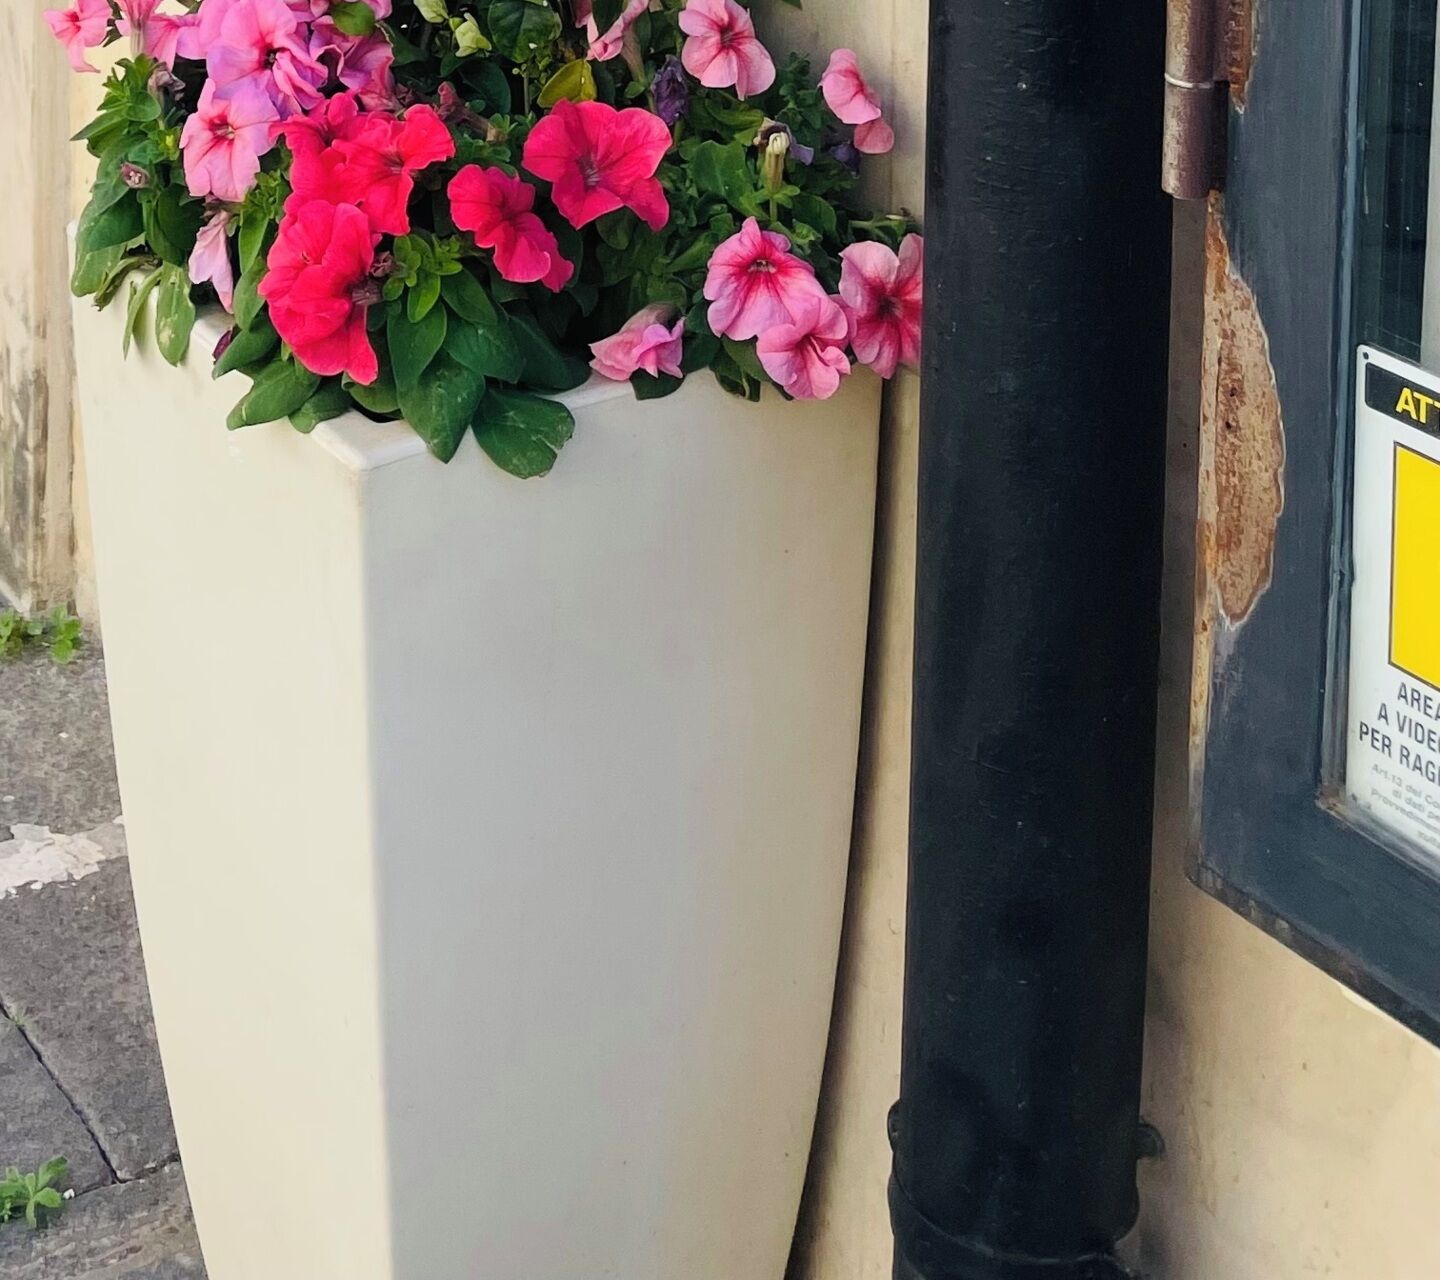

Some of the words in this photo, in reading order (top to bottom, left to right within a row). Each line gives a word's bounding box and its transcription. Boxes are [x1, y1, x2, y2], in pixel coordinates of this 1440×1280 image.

[1360, 721, 1392, 758] PER
[1377, 702, 1389, 726] A
[1396, 709, 1440, 754] VIDE
